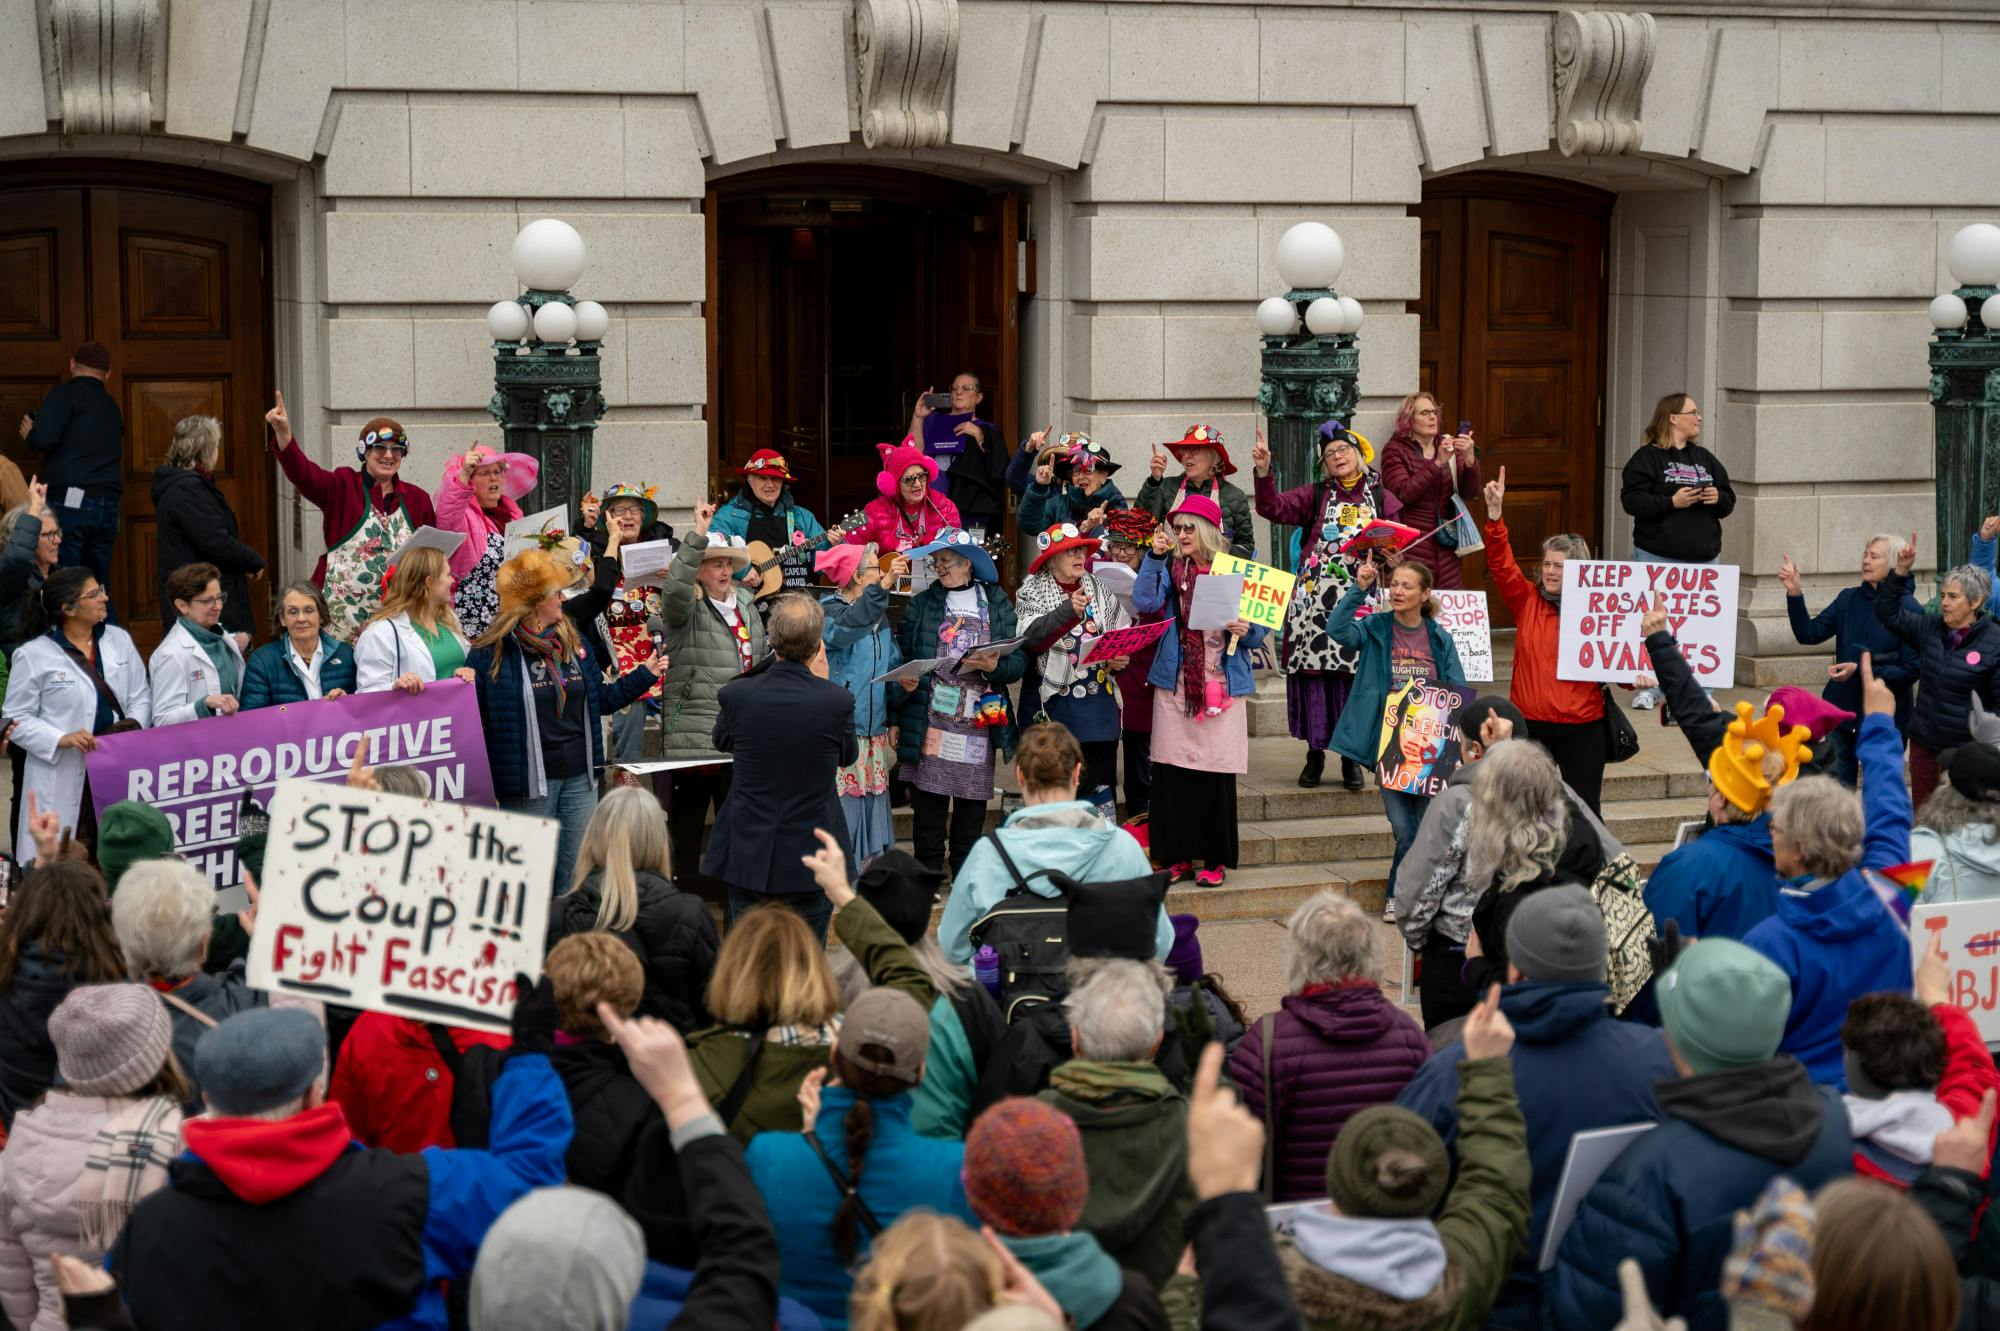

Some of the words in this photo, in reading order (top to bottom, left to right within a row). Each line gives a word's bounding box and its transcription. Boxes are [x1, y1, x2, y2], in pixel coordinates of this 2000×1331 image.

[1231, 560, 1269, 581] LET
[1578, 564, 1632, 588] KEEP
[1646, 564, 1719, 591] YOUR
[1237, 579, 1286, 607] MEN
[1241, 597, 1277, 624] IDE
[1440, 610, 1485, 626] STOP
[1580, 614, 1626, 637] OFF
[1640, 616, 1688, 639] Y
[1579, 641, 1721, 675] OVAES
[1407, 677, 1462, 713] STOP
[1385, 705, 1461, 742] SILENCIN
[127, 716, 454, 803] REPRODUCTIVE
[292, 803, 433, 885] STOP
[463, 821, 526, 865] the
[272, 923, 367, 982] Fight
[1948, 965, 1999, 1012] BJ
